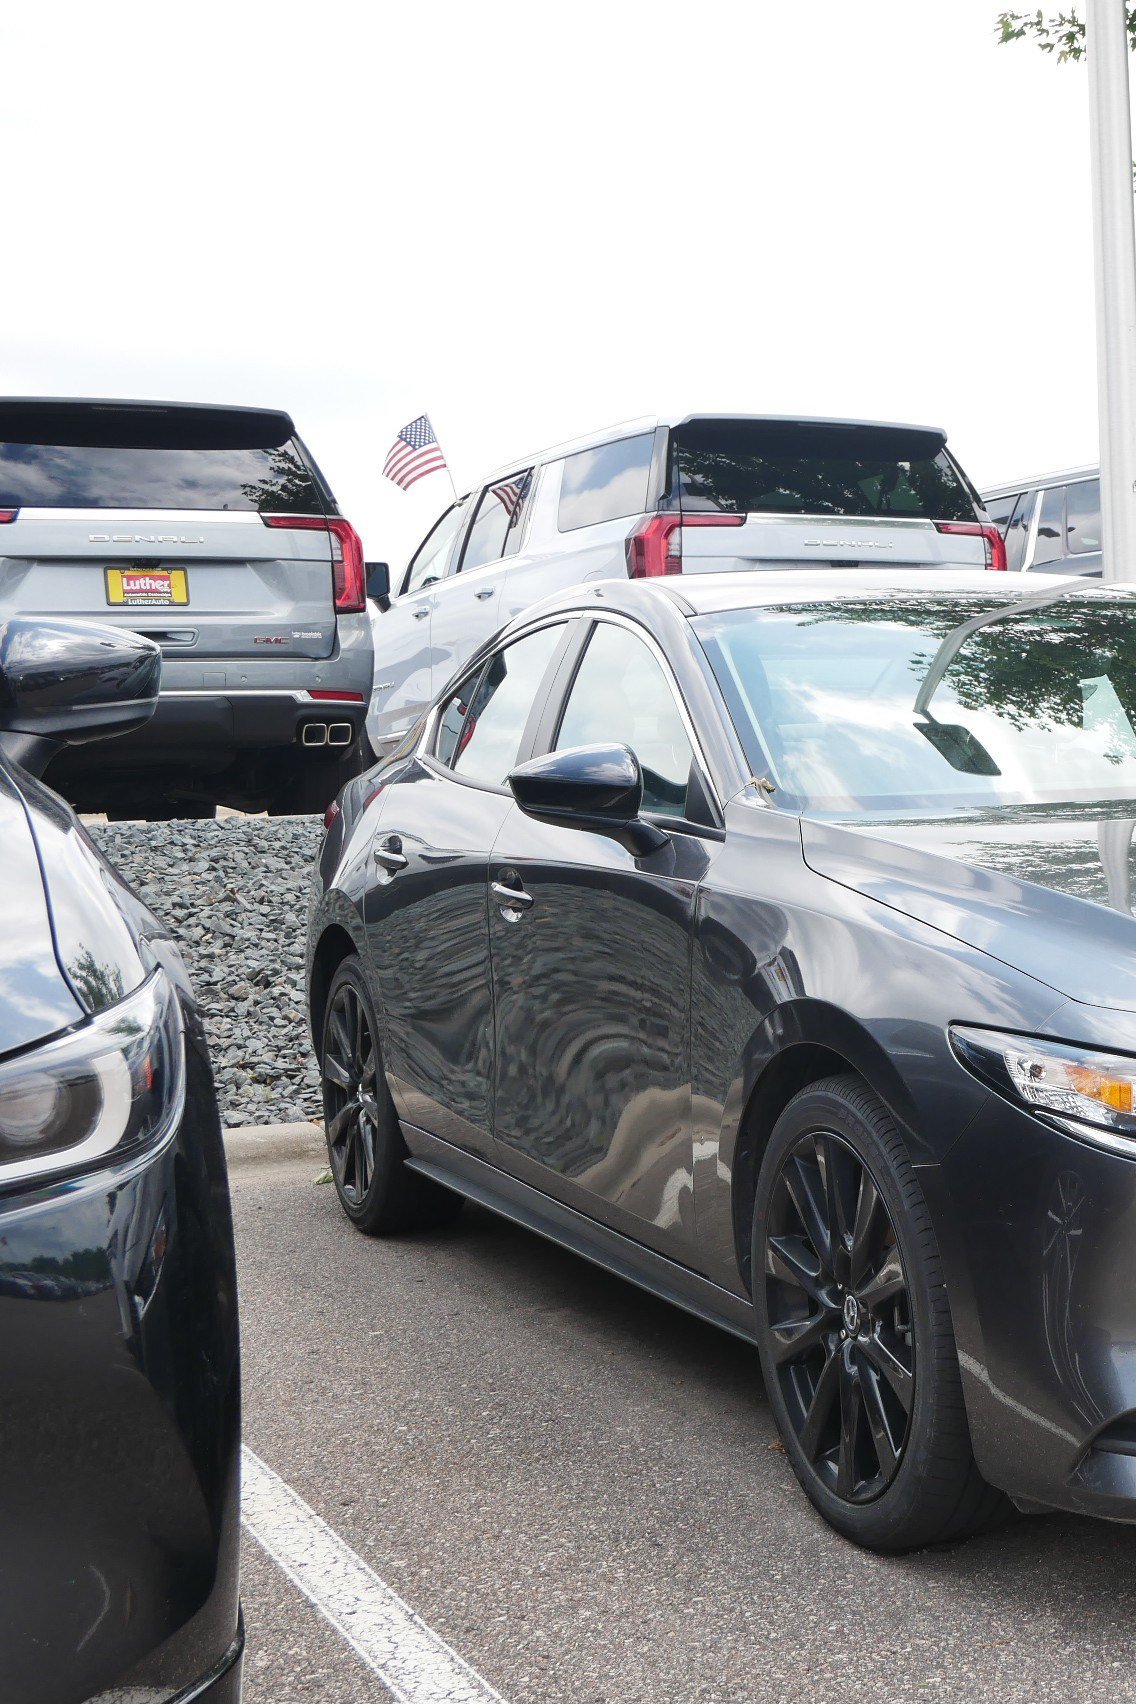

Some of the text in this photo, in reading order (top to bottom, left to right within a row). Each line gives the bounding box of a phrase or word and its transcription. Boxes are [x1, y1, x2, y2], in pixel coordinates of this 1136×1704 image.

[88, 534, 205, 544] DENALI
[803, 540, 893, 548] DENALI
[122, 576, 170, 590] Luther
[253, 636, 290, 644] GMC
